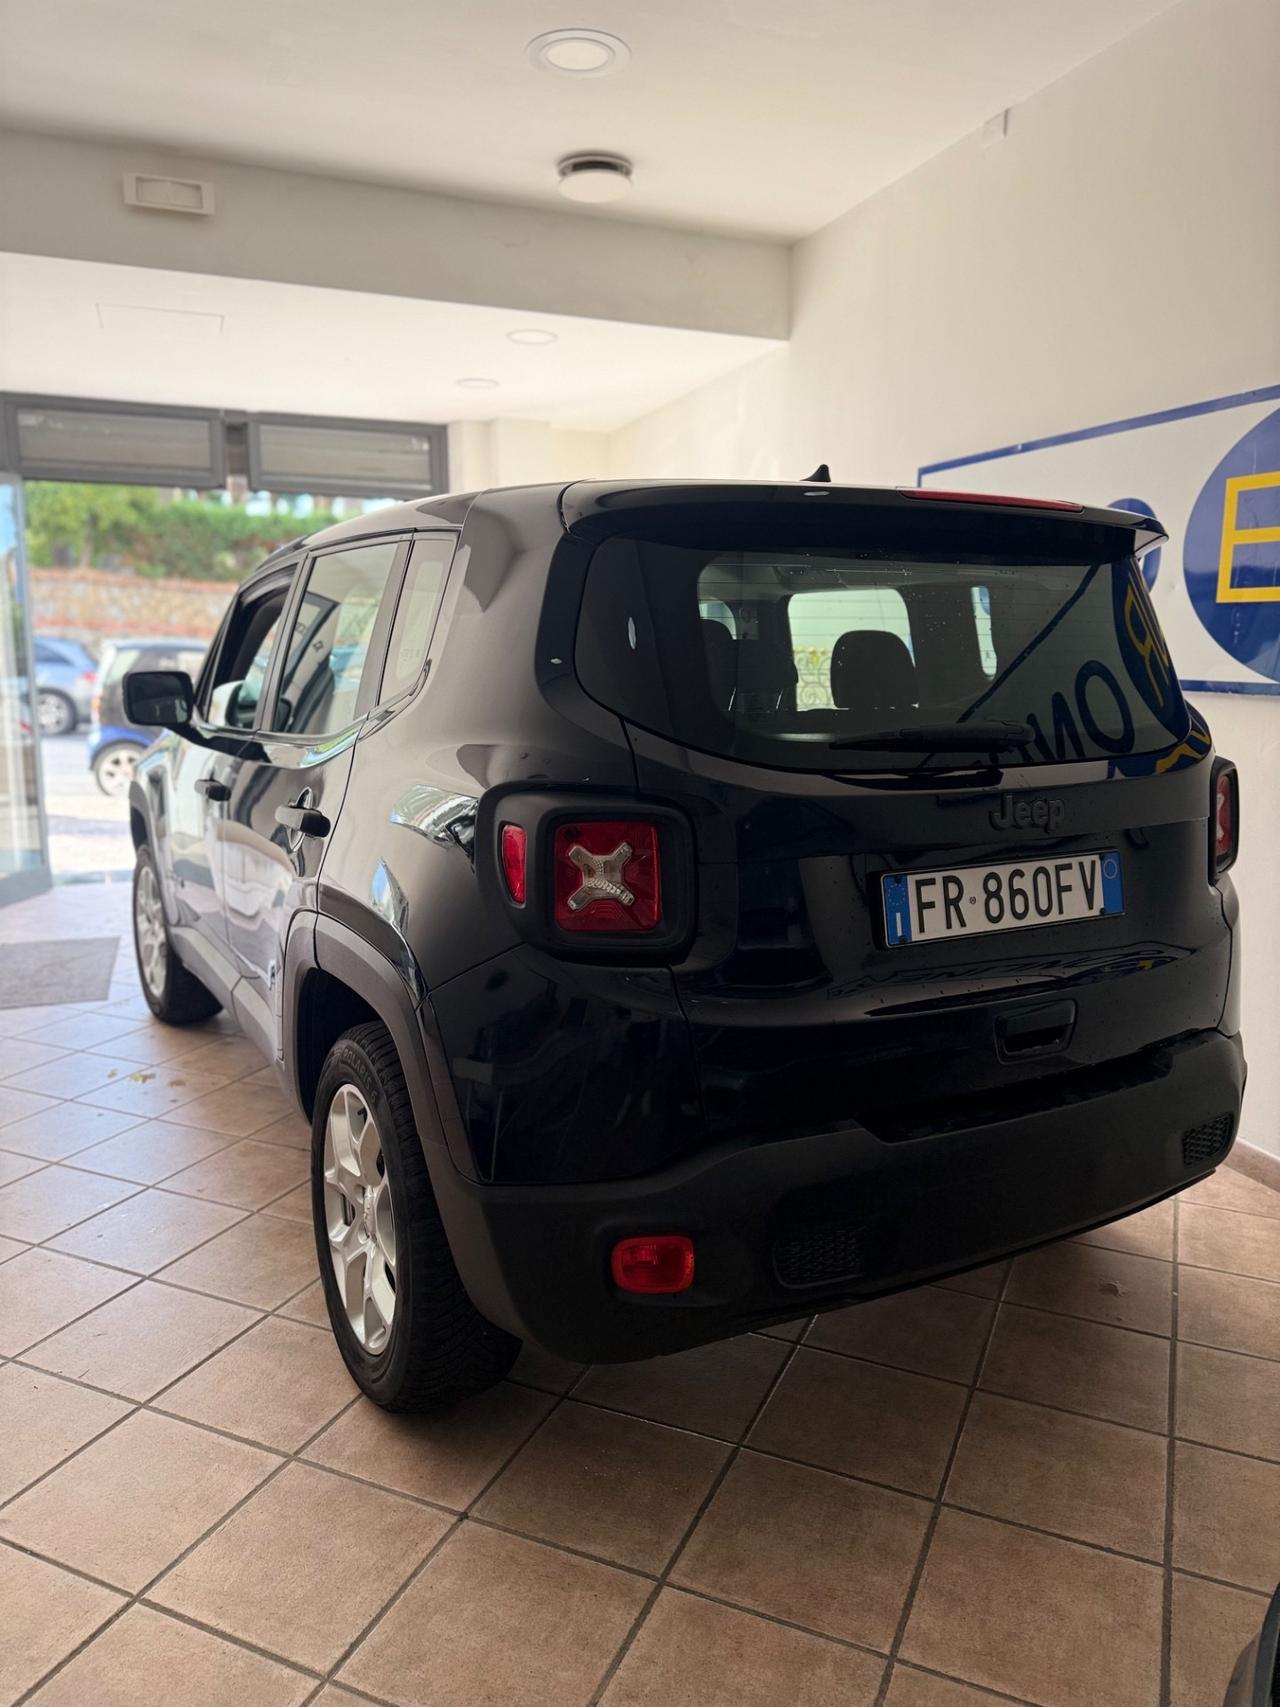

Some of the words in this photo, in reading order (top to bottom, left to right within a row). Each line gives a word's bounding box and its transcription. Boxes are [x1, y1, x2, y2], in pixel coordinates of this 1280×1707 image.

[989, 793, 1064, 832] Jeep
[915, 875, 967, 934] FR
[983, 859, 1096, 924] 860FV
